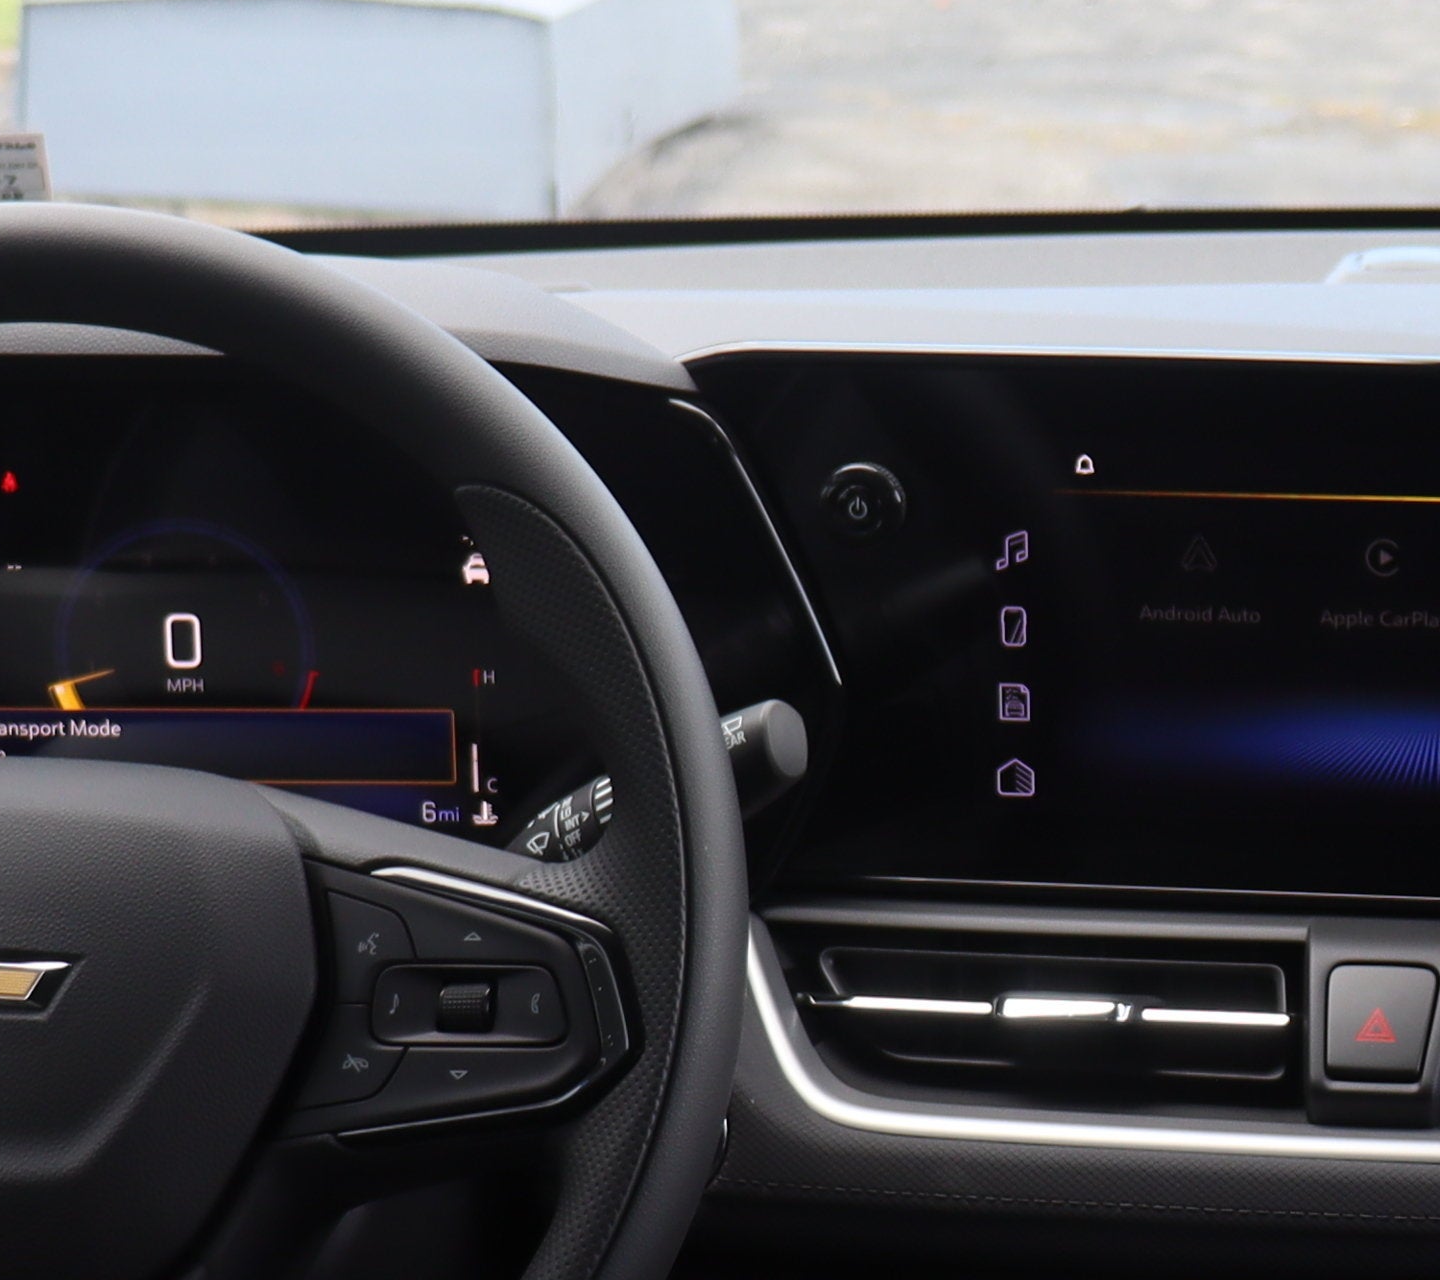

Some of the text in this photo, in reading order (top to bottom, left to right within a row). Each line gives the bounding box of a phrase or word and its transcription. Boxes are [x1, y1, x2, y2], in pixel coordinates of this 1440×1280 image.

[1139, 603, 1262, 624] Android Auto
[1321, 608, 1369, 630] Apple
[164, 612, 202, 669] 0
[167, 677, 205, 693] MPH
[483, 670, 496, 685] H
[70, 718, 122, 738] Mode
[487, 778, 499, 794] C
[564, 830, 582, 848] OFF
